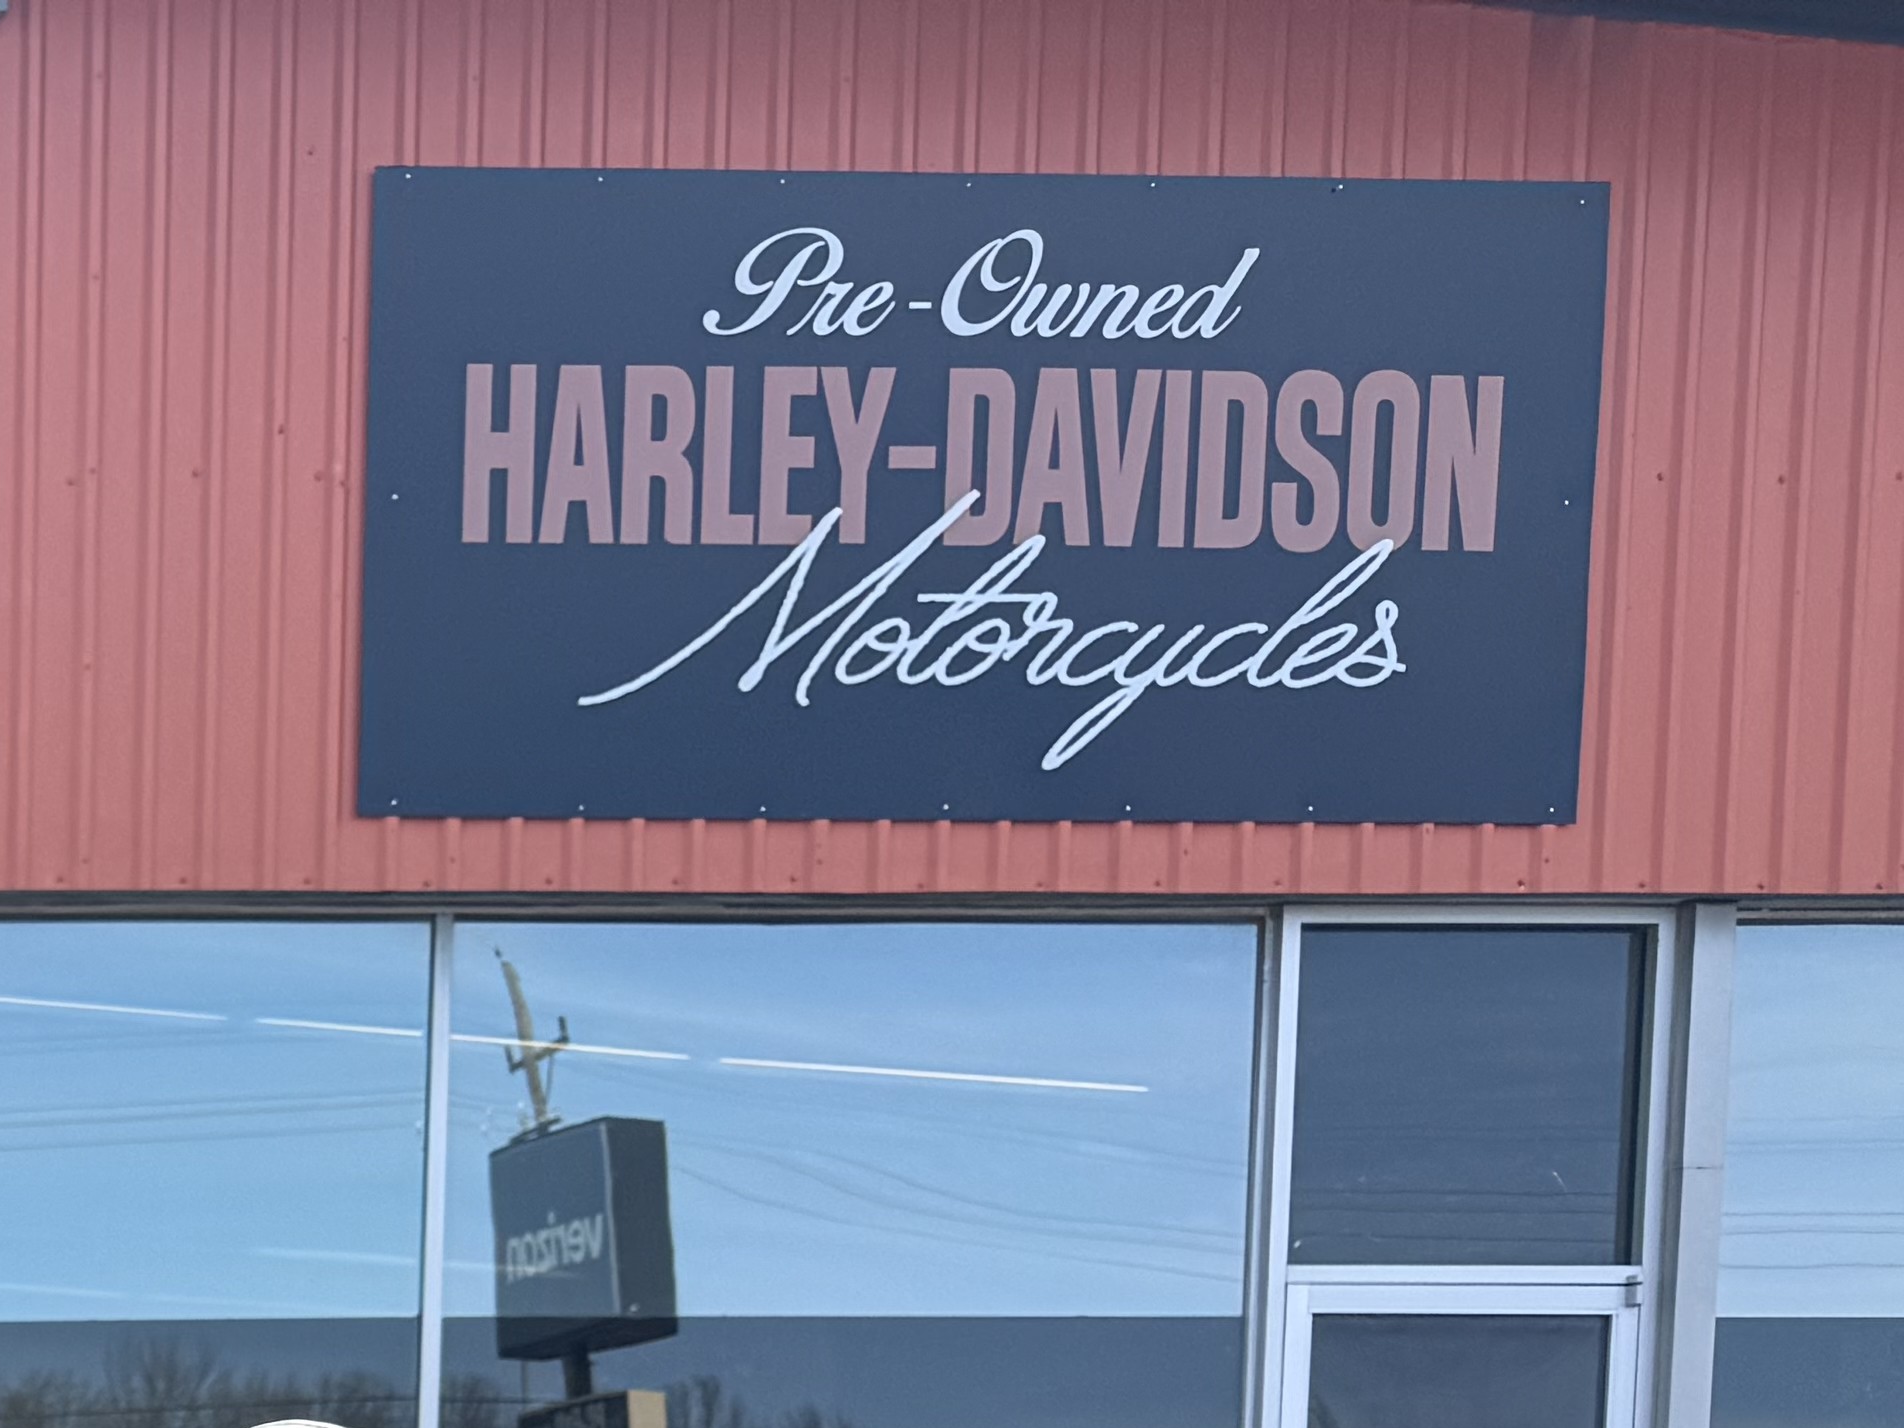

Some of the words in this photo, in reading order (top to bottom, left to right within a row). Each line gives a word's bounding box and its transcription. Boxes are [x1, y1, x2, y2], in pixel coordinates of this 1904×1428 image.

[702, 226, 1261, 339] Pre-Owned
[459, 361, 1506, 553] HARLEY-DAVIDSON
[577, 487, 1407, 770] Motorcycles
